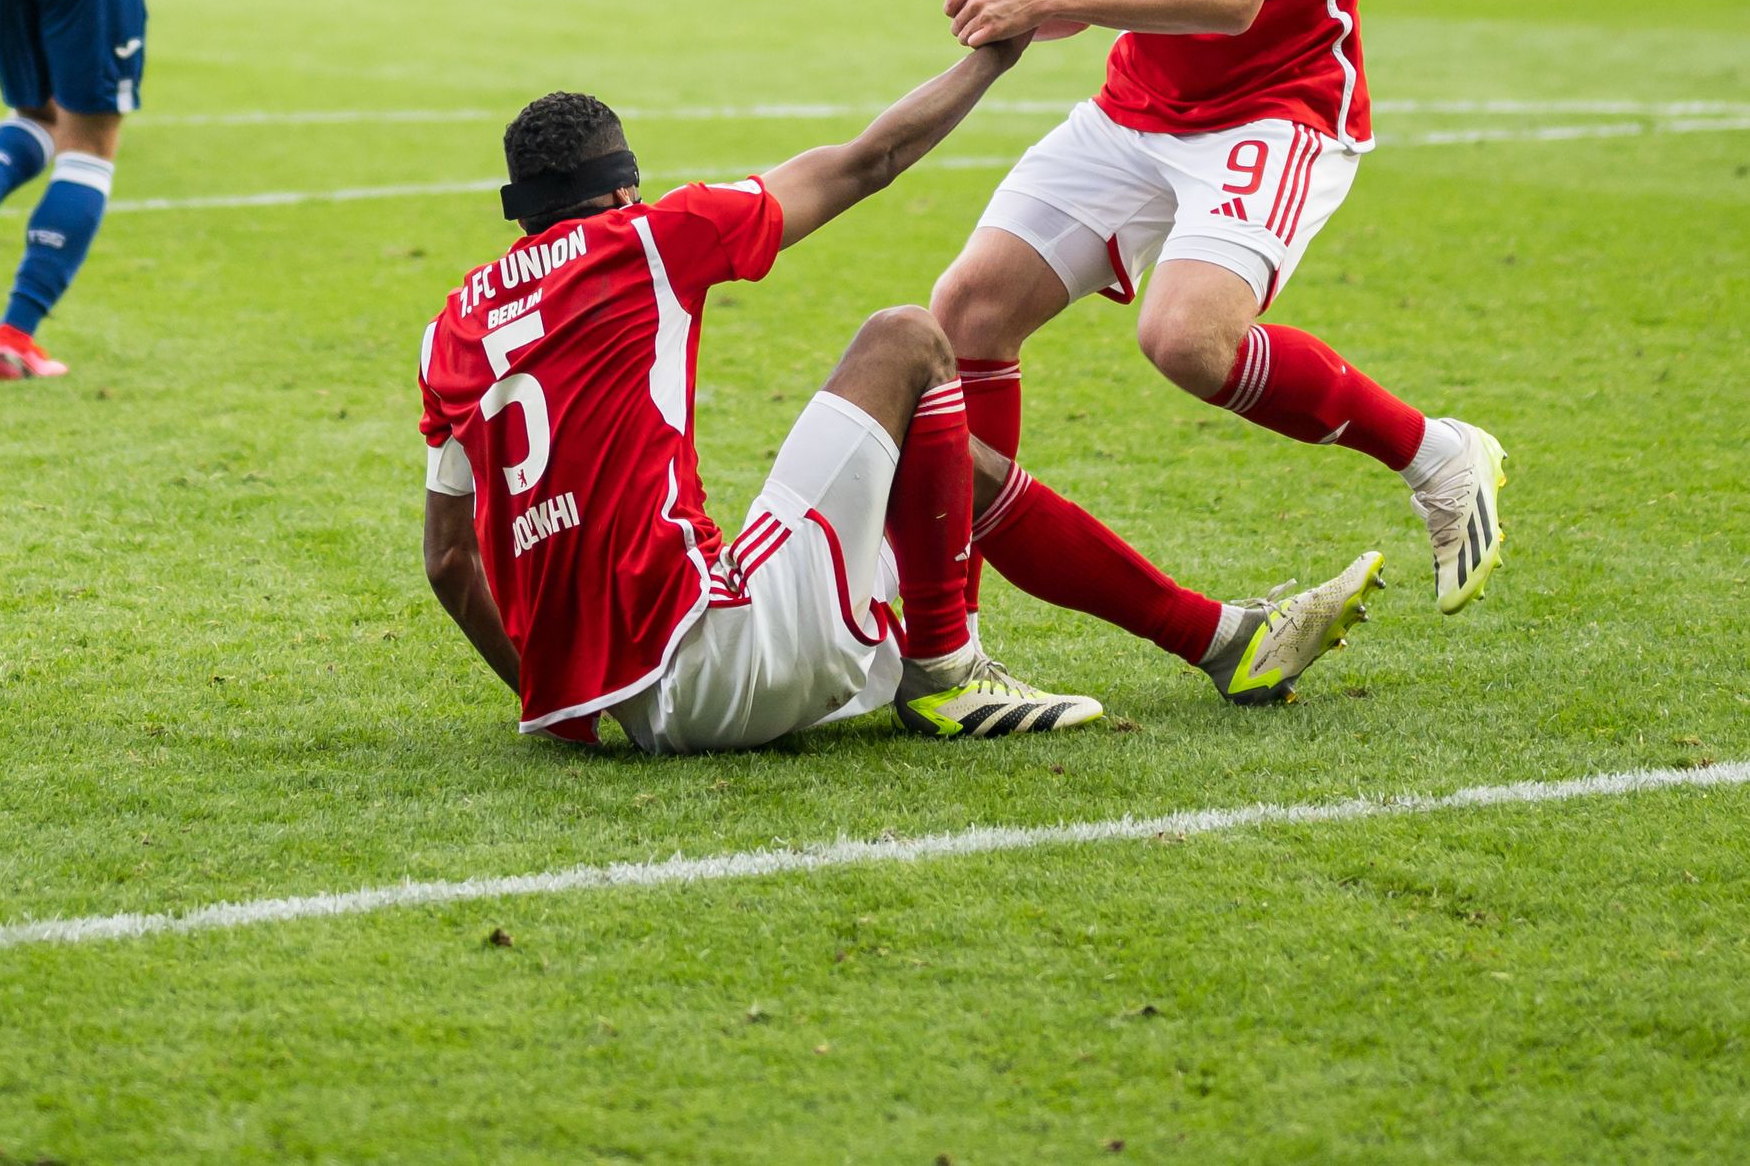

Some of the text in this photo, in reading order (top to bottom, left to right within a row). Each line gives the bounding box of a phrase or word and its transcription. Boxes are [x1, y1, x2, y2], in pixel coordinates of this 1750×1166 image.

[1222, 140, 1269, 195] 9
[459, 223, 588, 319] 1.FC UNION
[487, 286, 543, 330] BERLIN
[480, 309, 550, 496] 5
